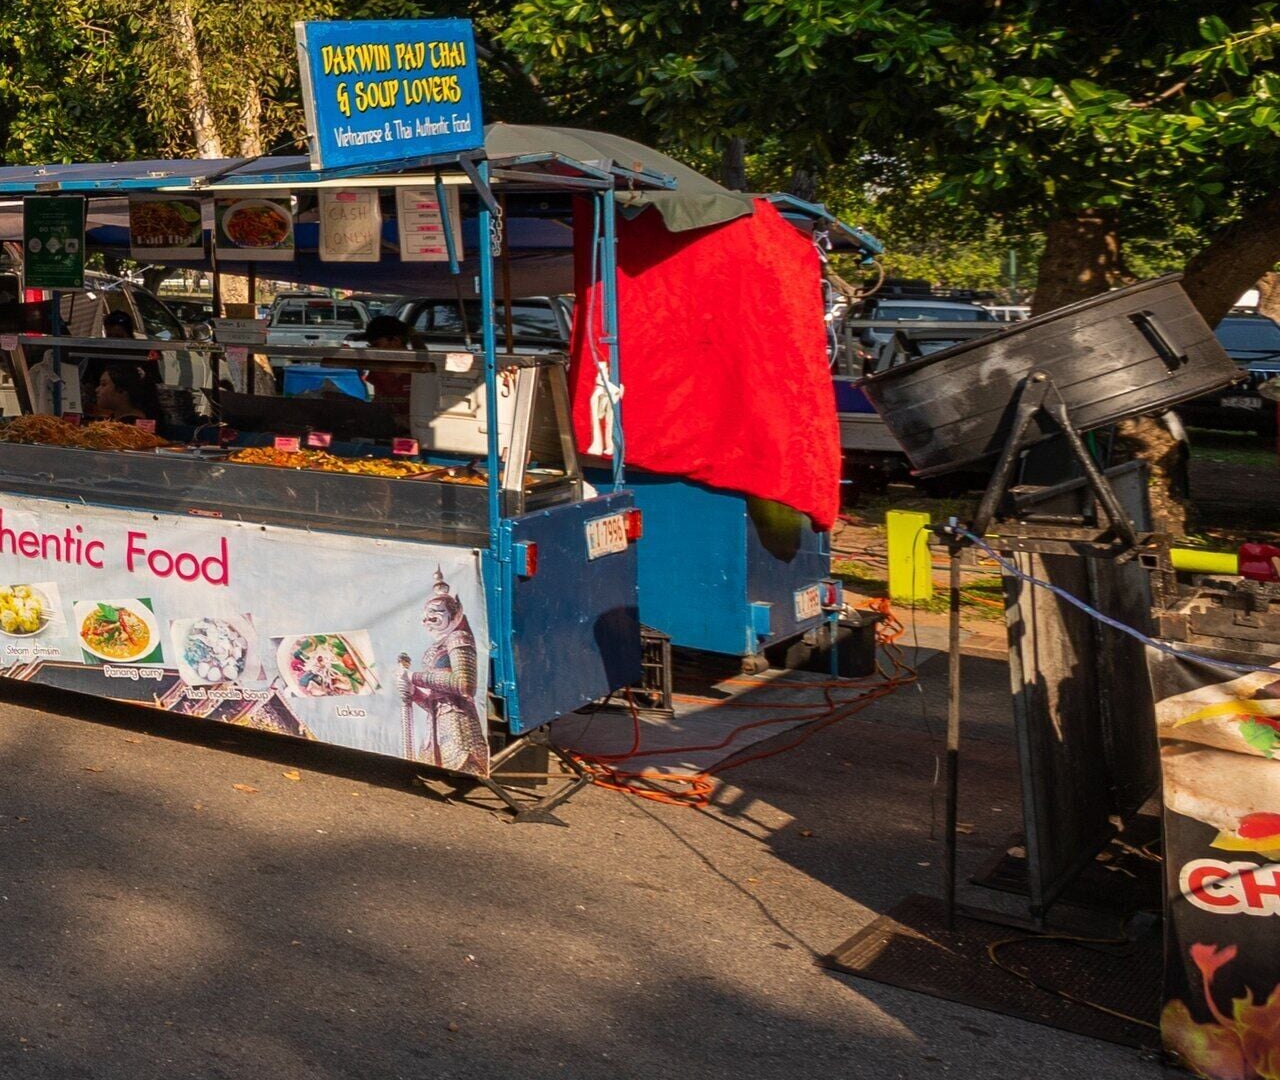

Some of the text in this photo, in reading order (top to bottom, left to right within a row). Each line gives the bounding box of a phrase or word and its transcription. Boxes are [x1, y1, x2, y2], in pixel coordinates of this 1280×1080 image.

[321, 41, 466, 75] DARWIN PAD THAI
[337, 74, 462, 117] & SOUP LOVERS
[334, 112, 472, 148] Vietnamese & Thai Authentic Food
[328, 207, 367, 221] CASH
[126, 530, 230, 587] Food
[6, 645, 30, 654] Steam
[105, 667, 163, 680] Panang curry
[187, 688, 269, 701] Thai noodle Soup
[1188, 866, 1280, 909] CH
